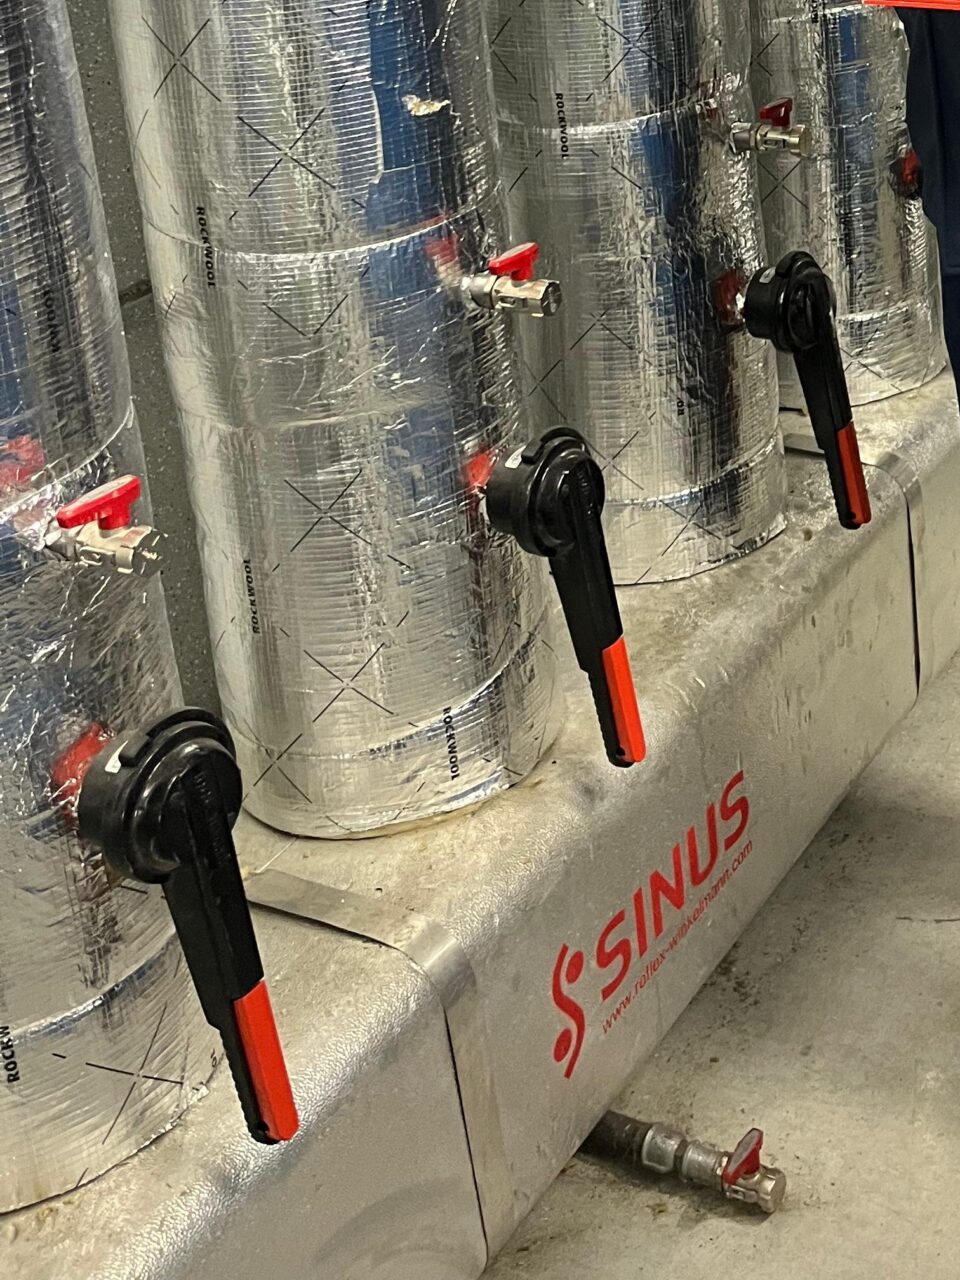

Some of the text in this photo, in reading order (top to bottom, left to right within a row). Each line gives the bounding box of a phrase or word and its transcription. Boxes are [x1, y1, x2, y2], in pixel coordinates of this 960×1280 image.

[556, 93, 569, 160] ROCKWOOL
[196, 206, 216, 289] ROCKWOOL
[243, 559, 260, 635] ROCKWOOL
[443, 706, 460, 781] ROCKWOOL
[596, 770, 749, 1002] SINUS
